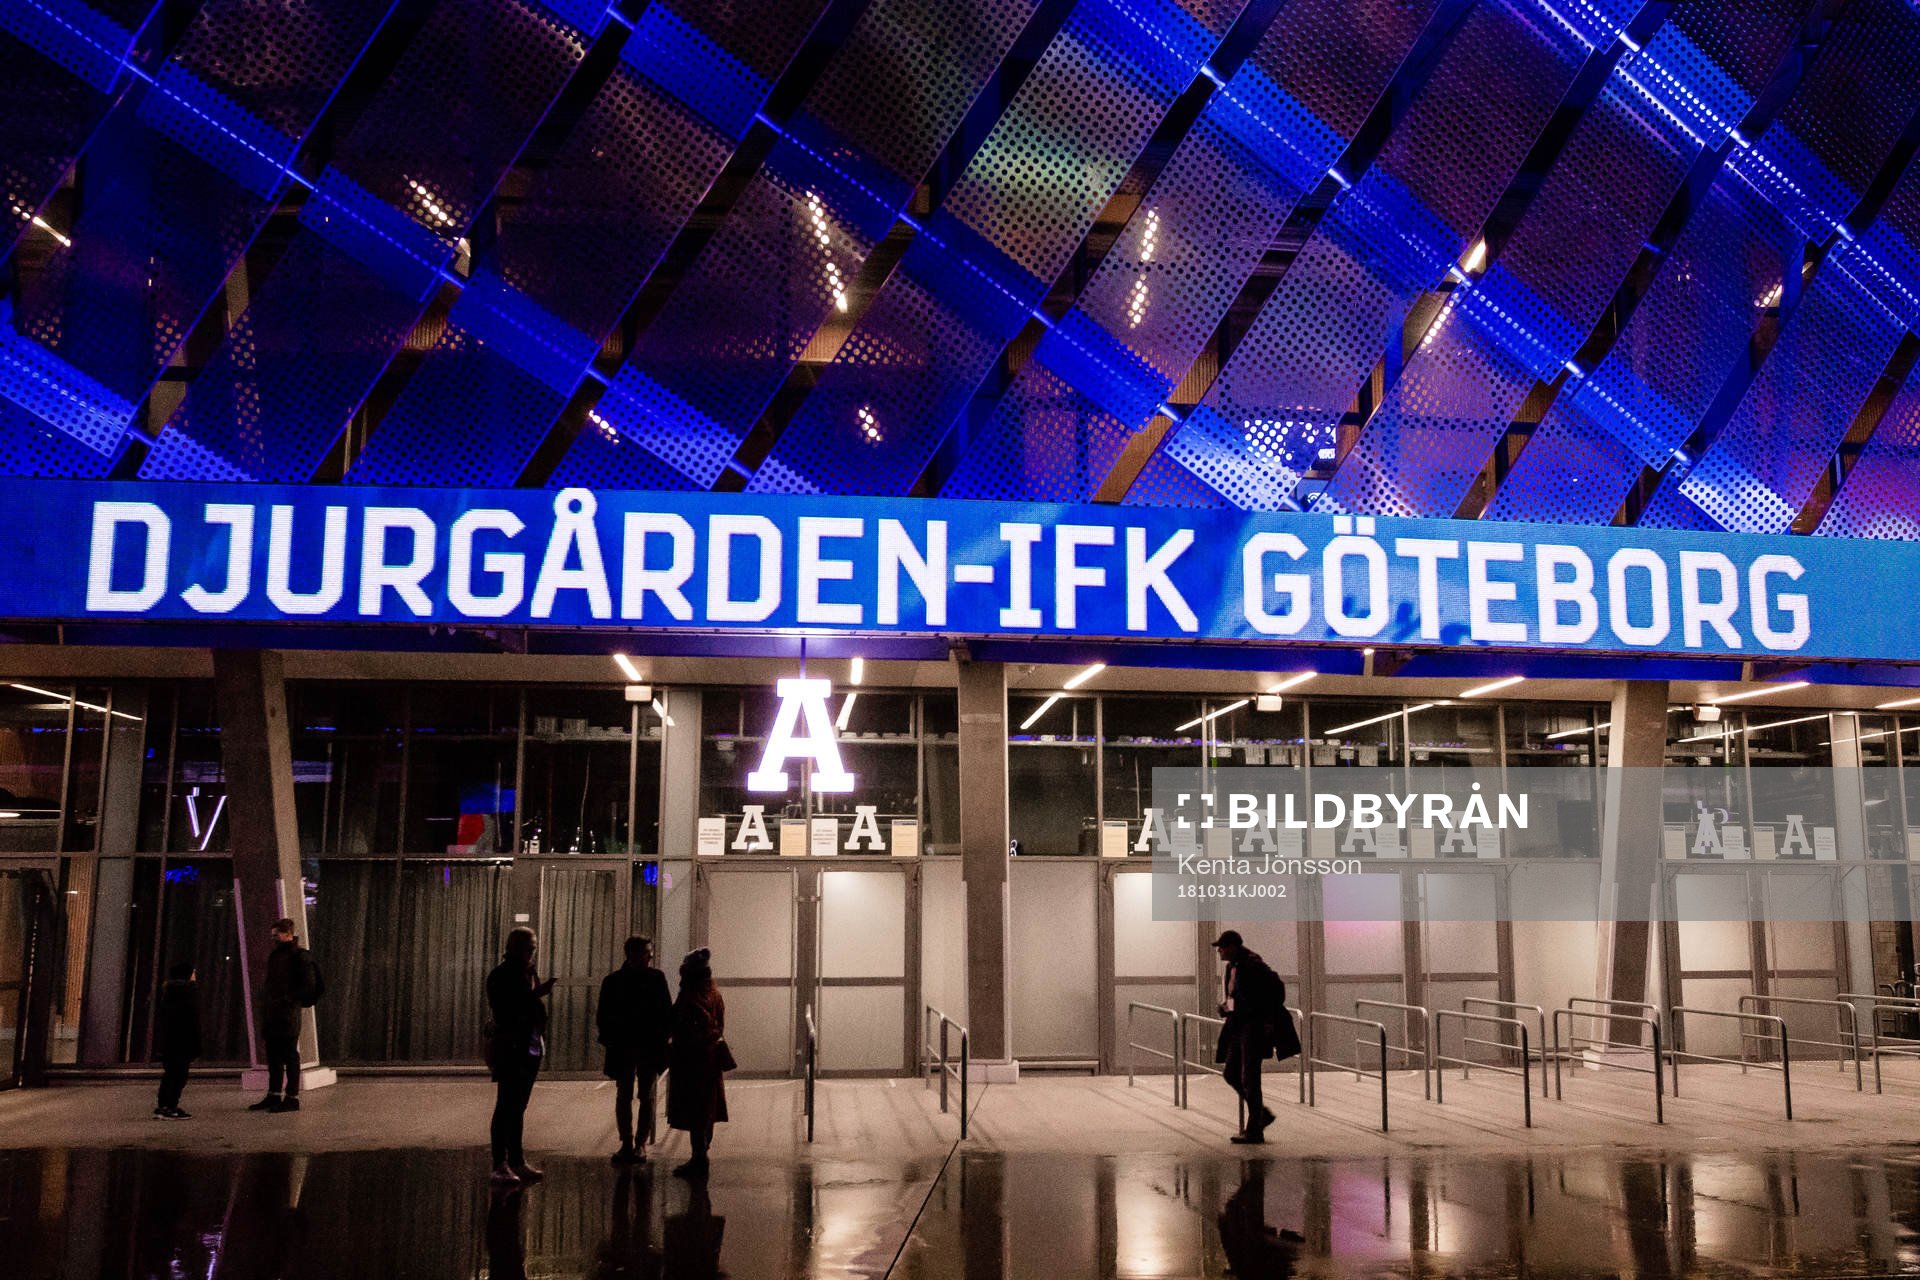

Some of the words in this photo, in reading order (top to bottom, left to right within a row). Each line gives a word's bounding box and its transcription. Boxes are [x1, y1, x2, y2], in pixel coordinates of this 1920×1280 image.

[86, 487, 1199, 633] DJURGÅRDEN-IFK
[1243, 515, 1811, 650] GÖTEBORG
[746, 677, 856, 793] A
[731, 805, 773, 850] A
[844, 805, 886, 850] A
[1134, 808, 1172, 852] A
[1780, 814, 1813, 854] A
